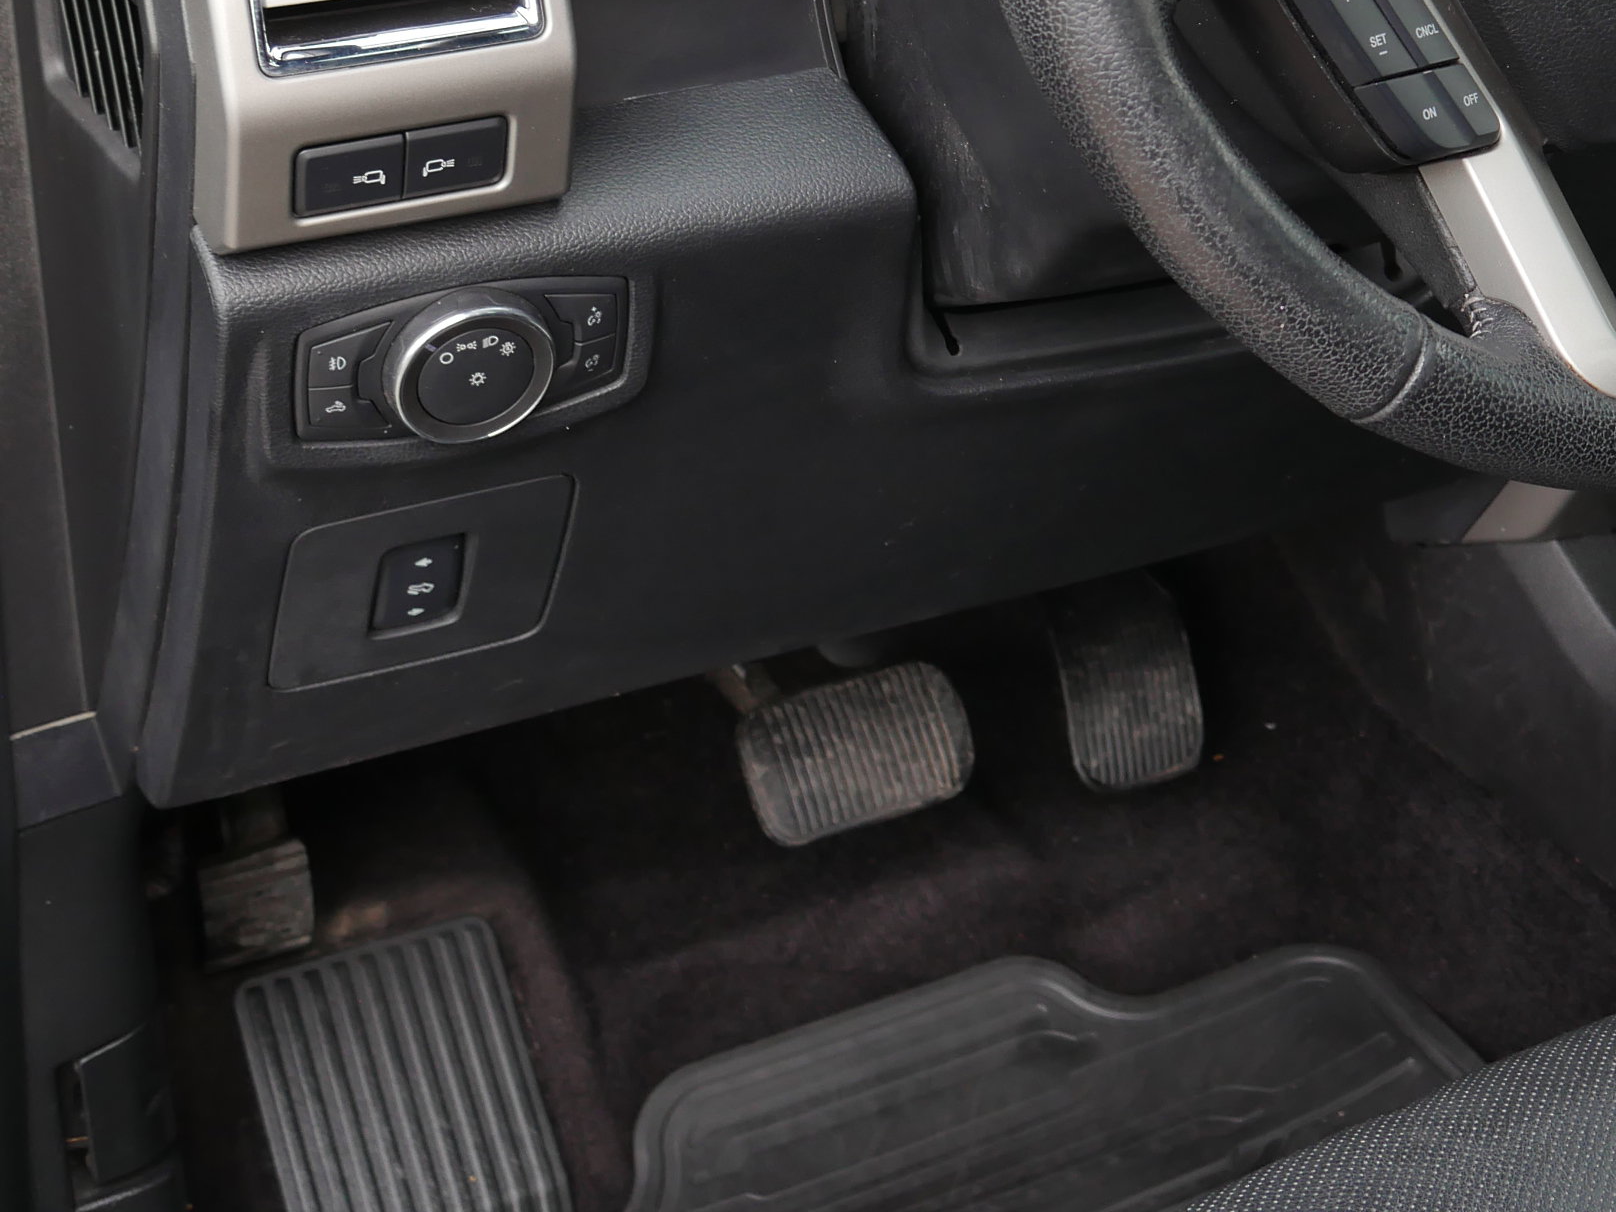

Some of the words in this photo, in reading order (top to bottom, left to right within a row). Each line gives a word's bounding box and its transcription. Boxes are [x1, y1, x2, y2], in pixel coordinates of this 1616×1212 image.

[1415, 23, 1439, 38] CNCL
[1369, 33, 1387, 48] SET
[1463, 92, 1479, 107] OFF
[1422, 106, 1437, 120] ON
